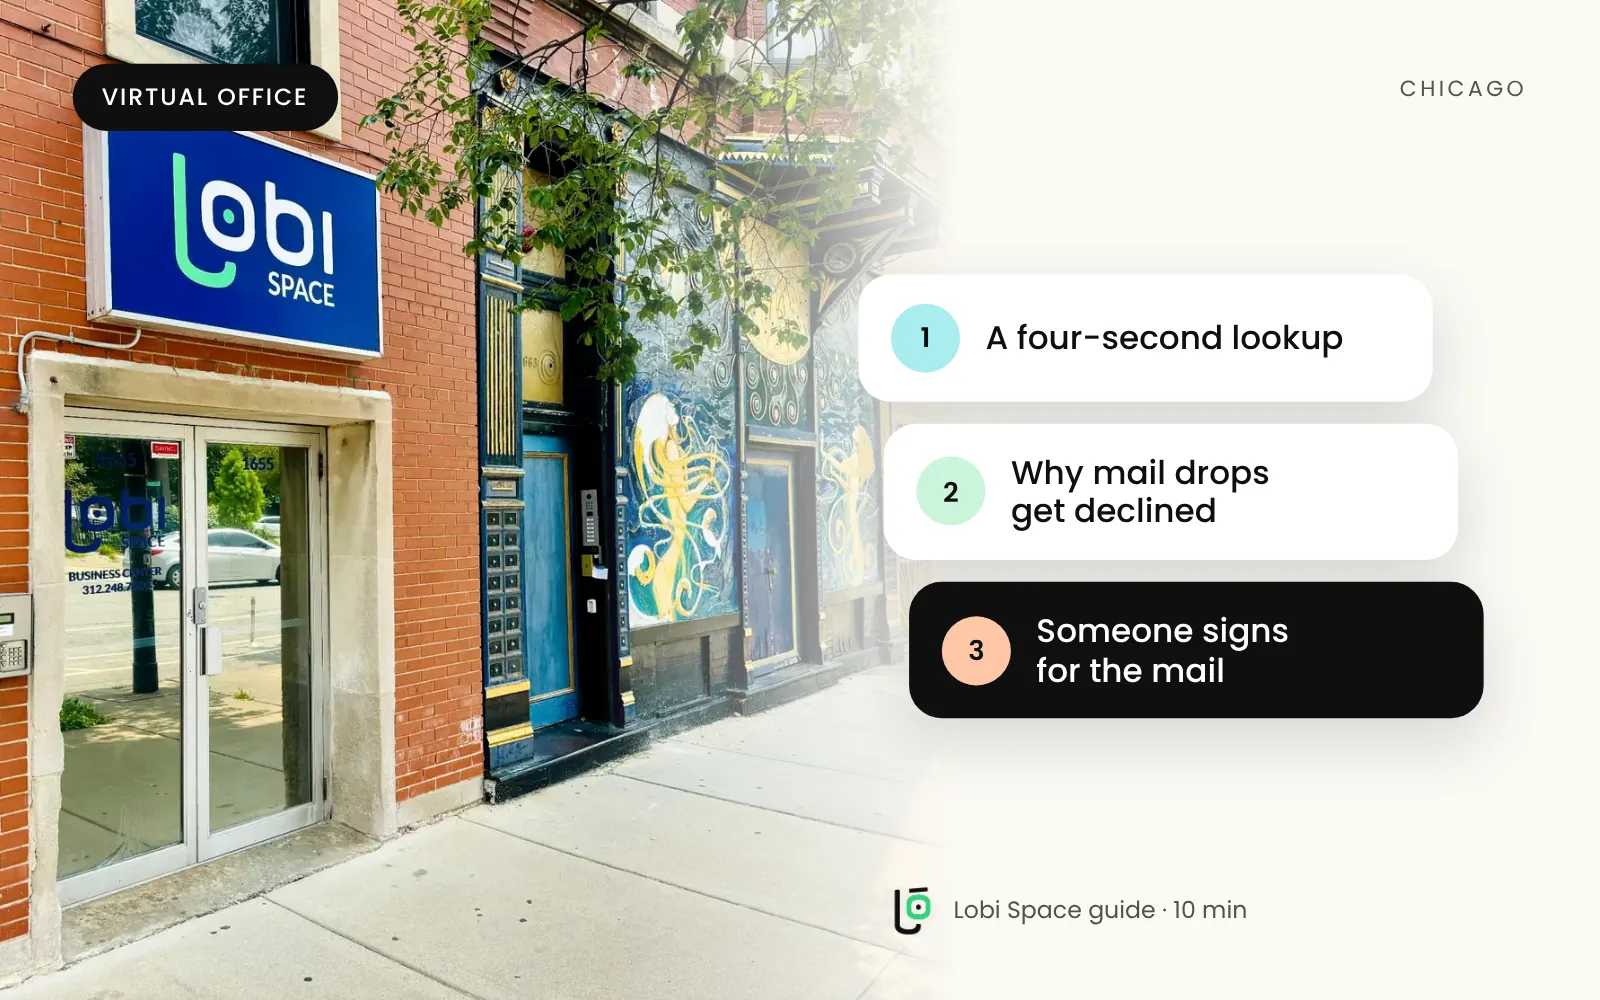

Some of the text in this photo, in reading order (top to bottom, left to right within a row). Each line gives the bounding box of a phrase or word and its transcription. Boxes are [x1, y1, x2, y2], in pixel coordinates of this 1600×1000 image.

[267, 272, 335, 307] SPACE
[243, 457, 275, 471] 1655
[68, 570, 121, 582] BUSINESS
